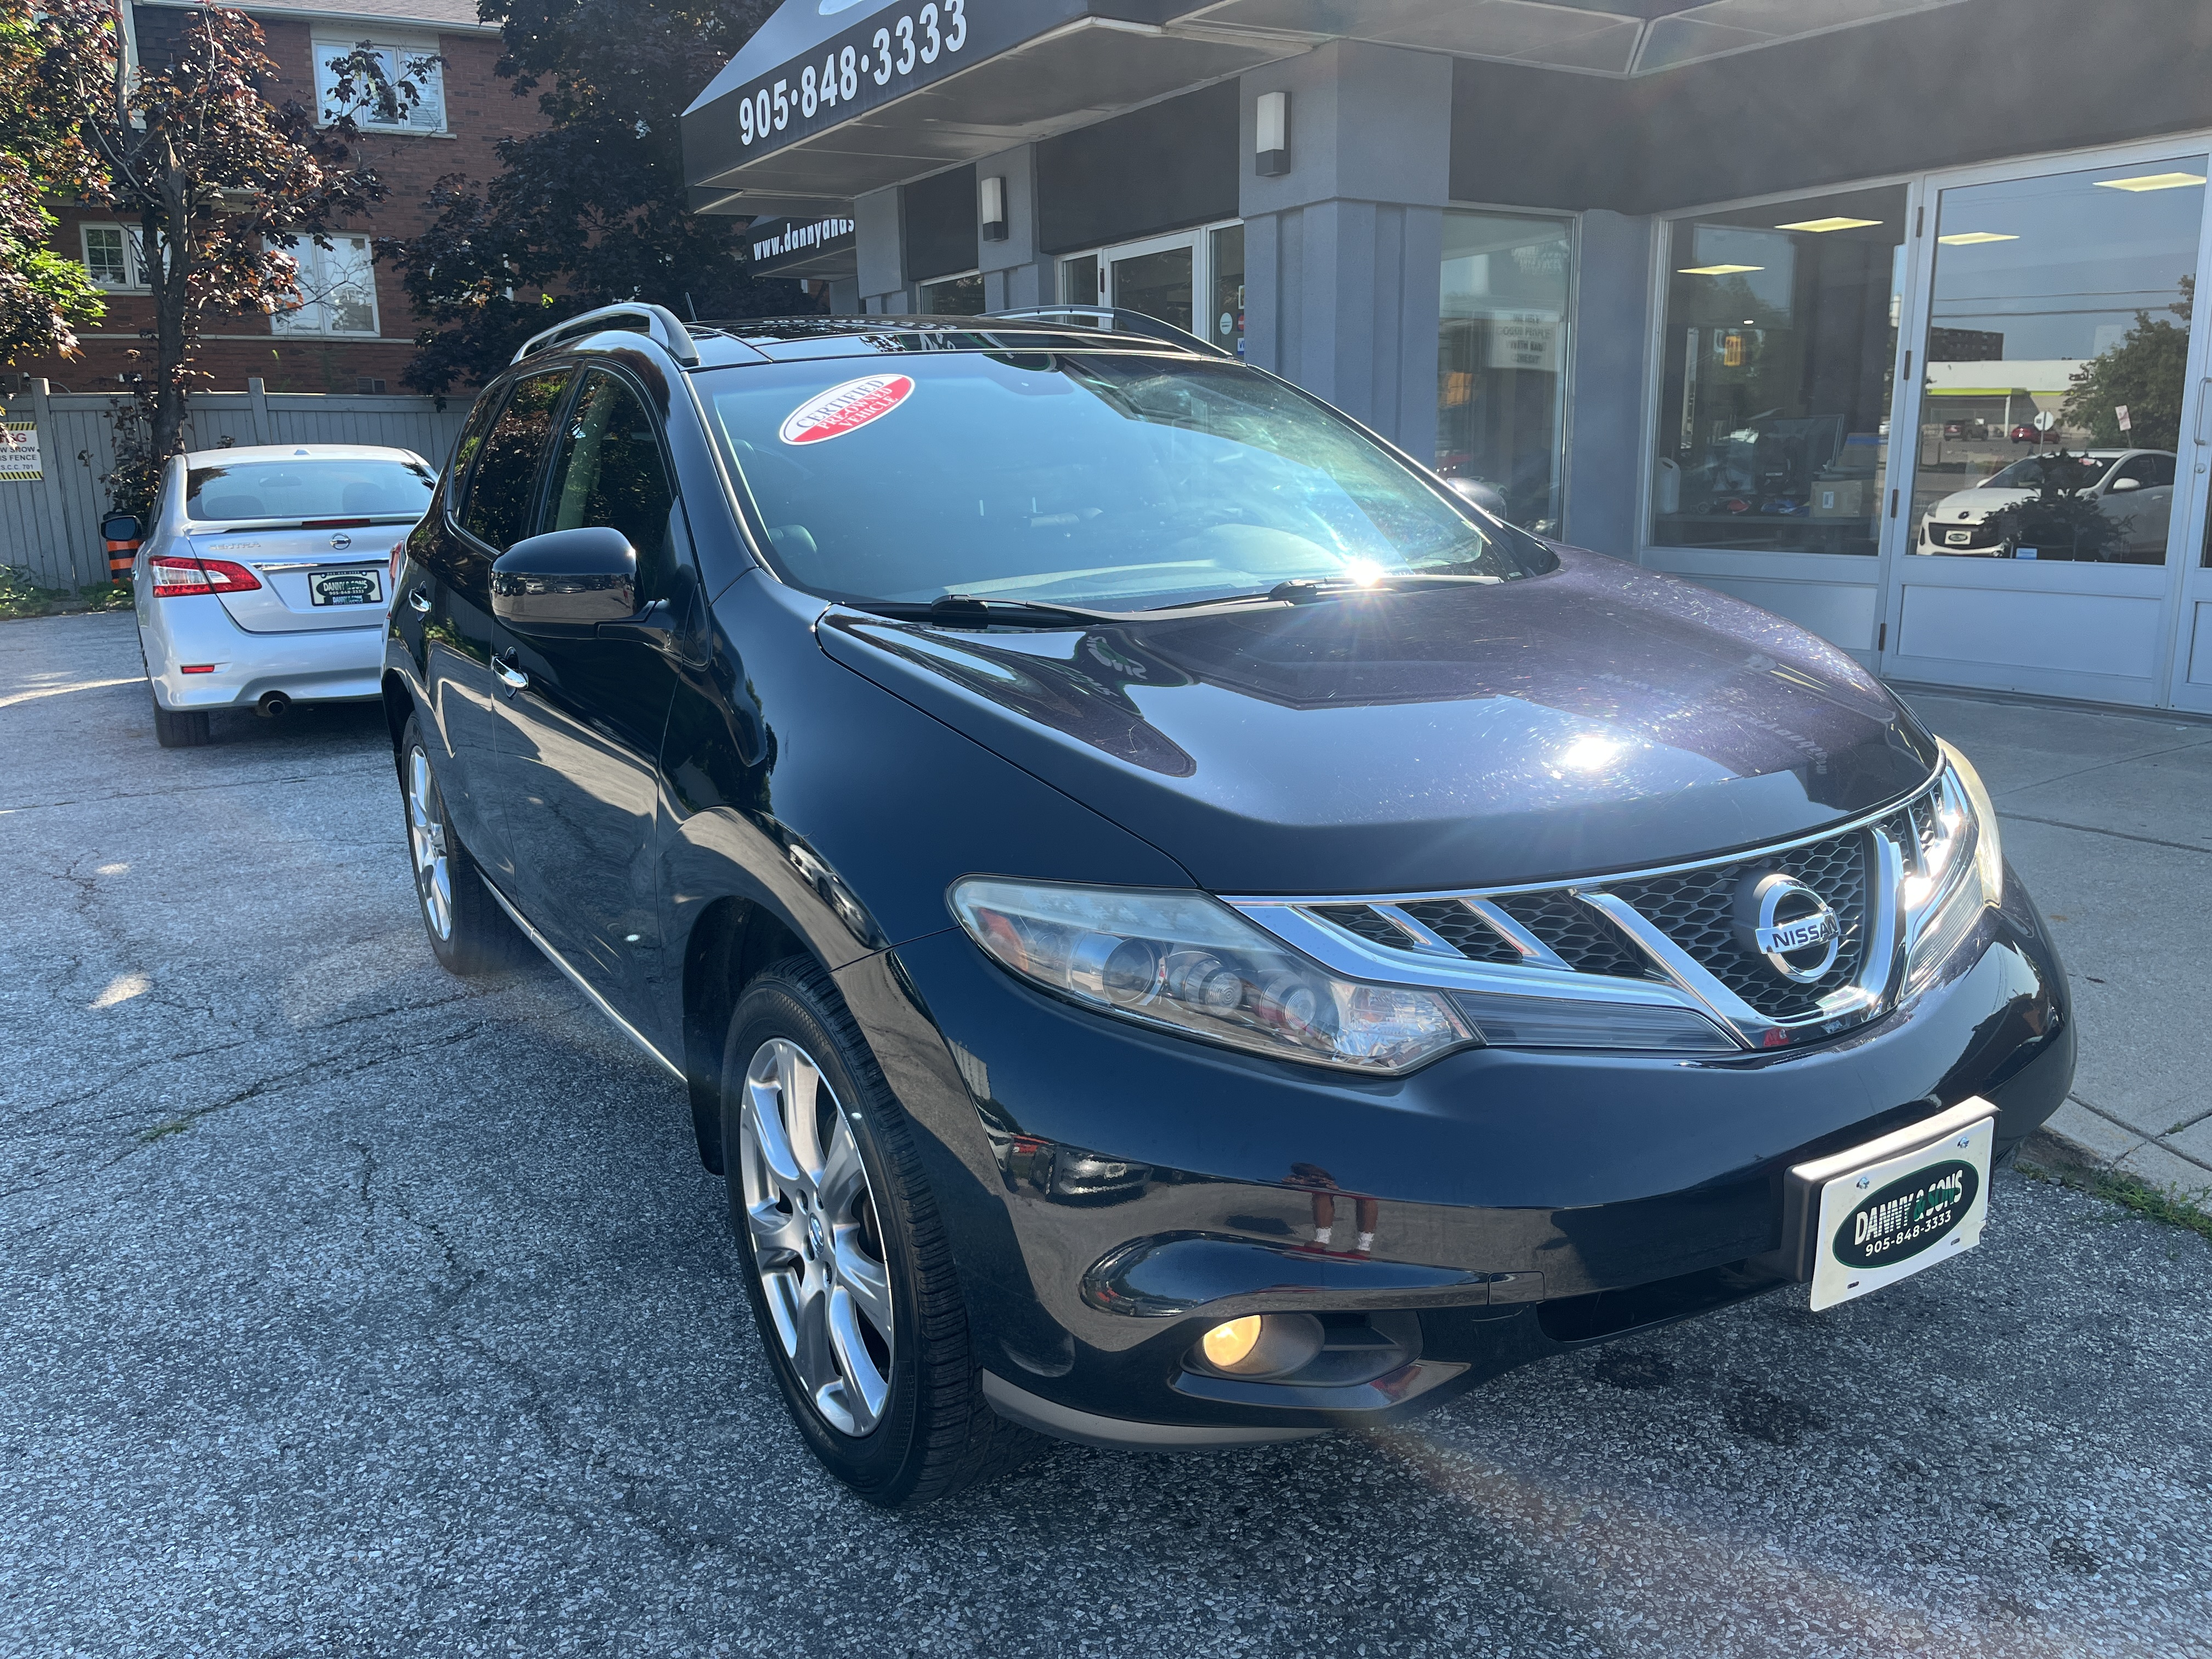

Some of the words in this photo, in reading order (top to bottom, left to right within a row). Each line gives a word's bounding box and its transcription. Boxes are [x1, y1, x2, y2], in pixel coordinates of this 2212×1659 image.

[796, 380, 884, 428] CERTIFIED
[817, 387, 893, 429] PRE-OWNED
[838, 396, 899, 427] VEHICLE
[323, 582, 345, 592] DANNY
[1772, 914, 1839, 948] NISSAN
[1854, 1193, 1914, 1245] DANNY
[1926, 1170, 1963, 1216] SONS
[1865, 1209, 1951, 1257] 905-848-3333
